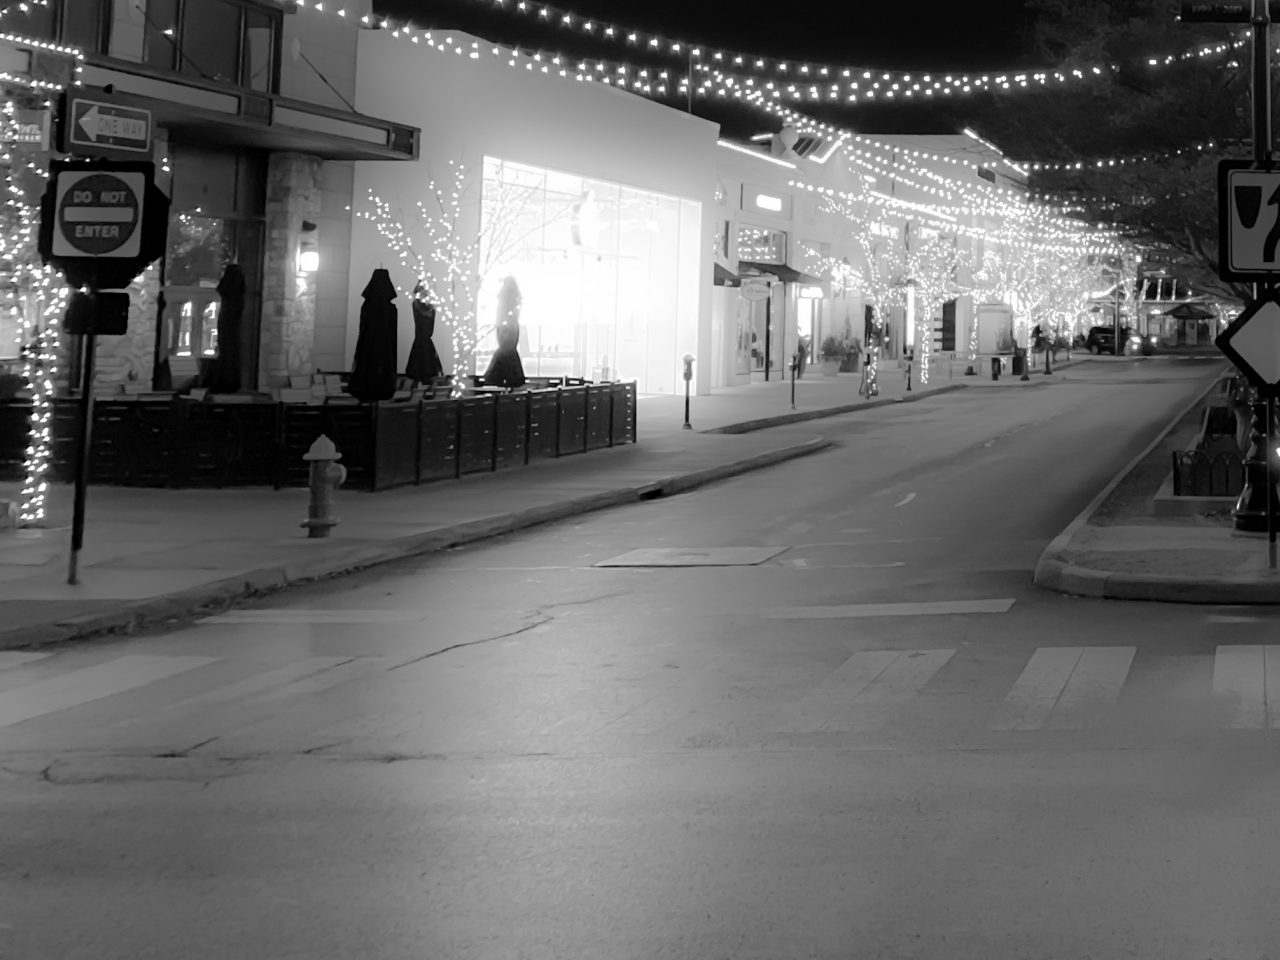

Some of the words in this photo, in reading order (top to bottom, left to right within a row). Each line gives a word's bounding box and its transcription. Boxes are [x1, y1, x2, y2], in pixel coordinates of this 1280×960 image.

[97, 117, 118, 134] ONE
[122, 120, 142, 135] WAY
[73, 190, 92, 203] DO
[100, 191, 127, 203] NOT
[75, 224, 120, 238] ENTER
